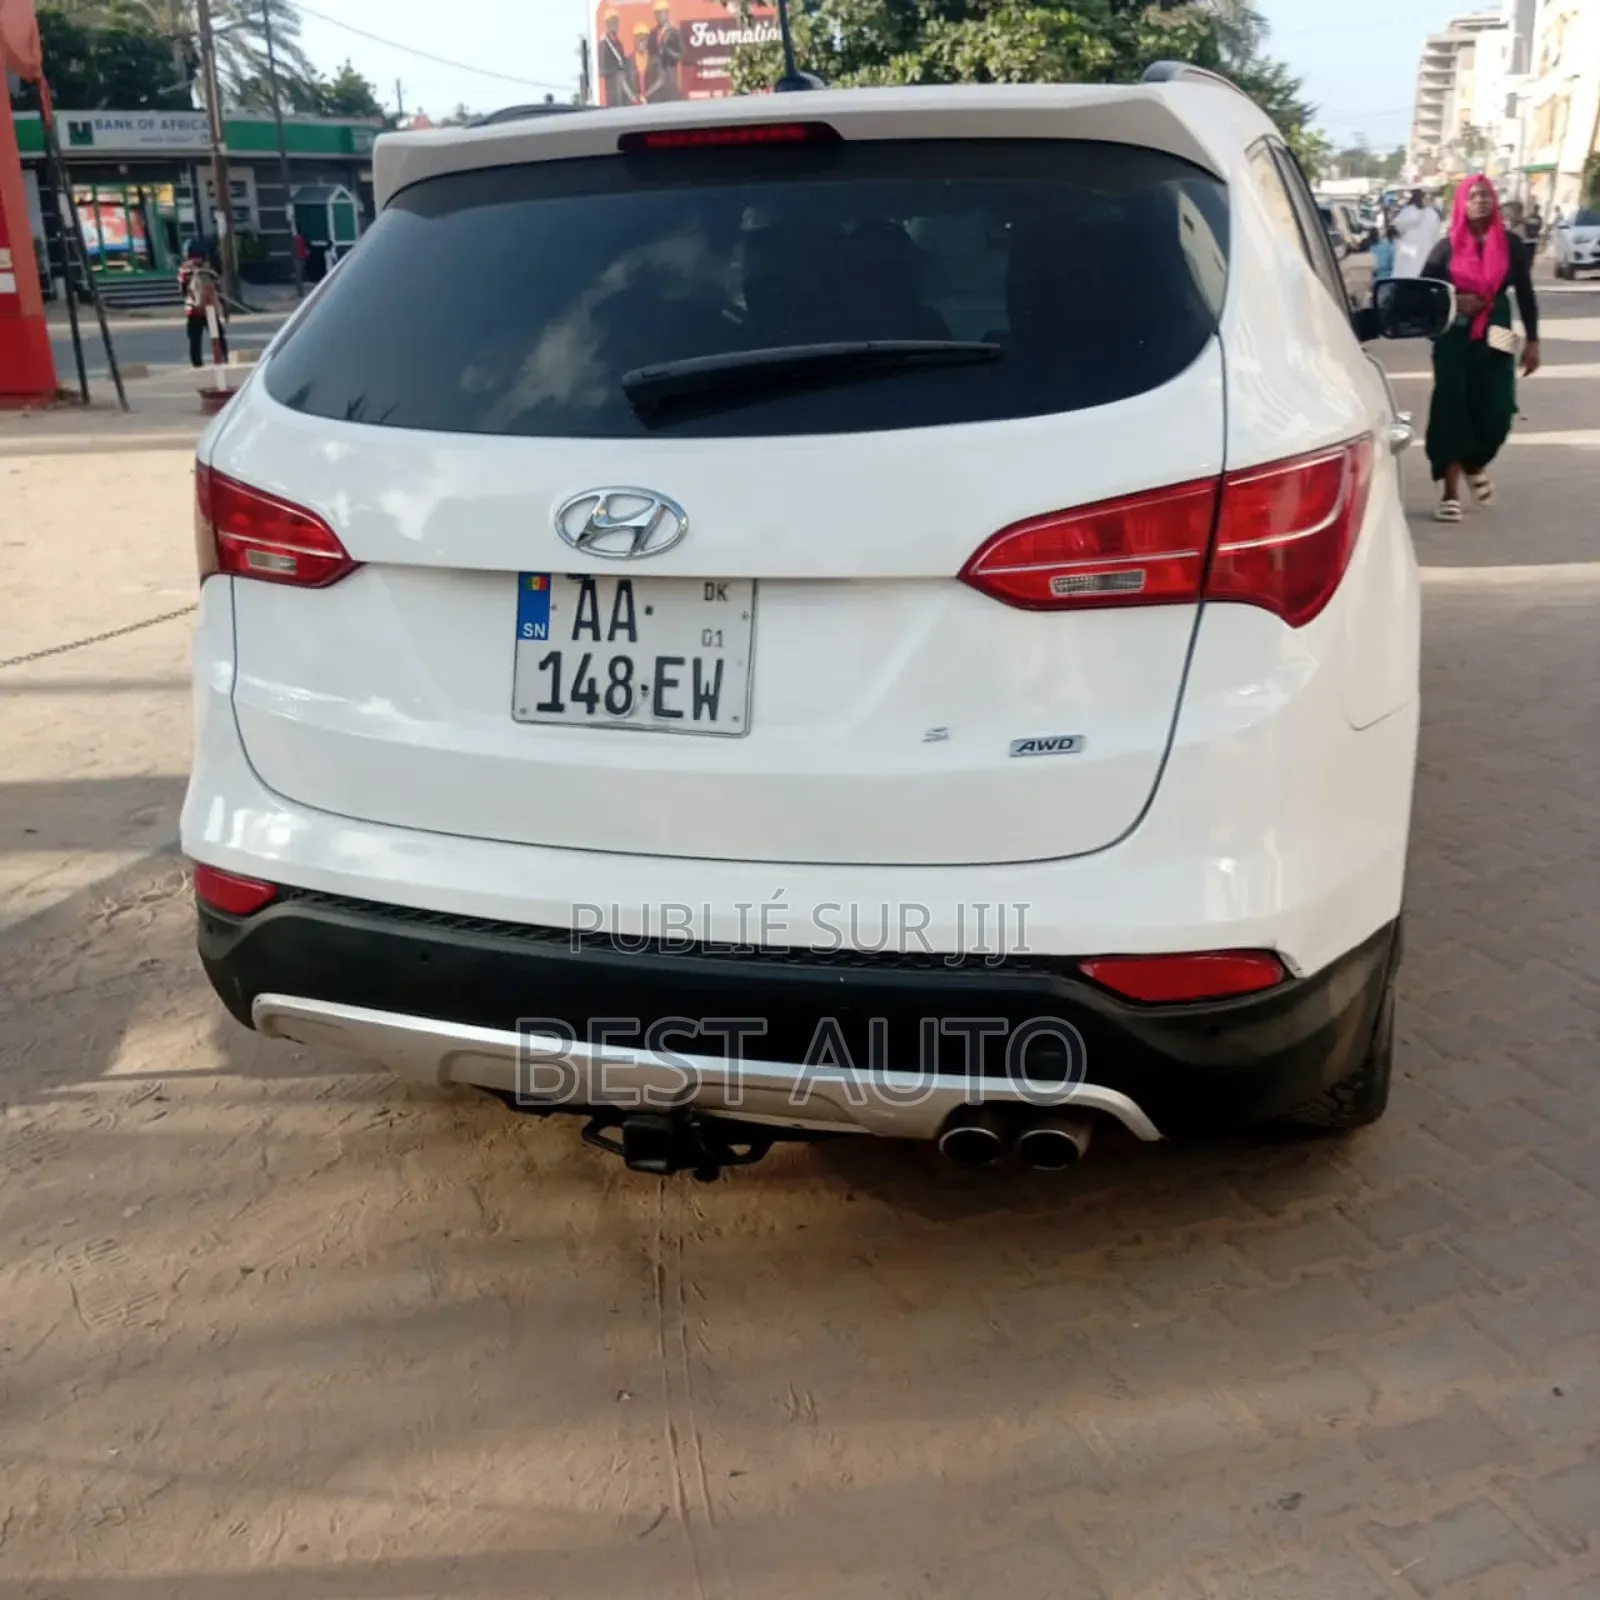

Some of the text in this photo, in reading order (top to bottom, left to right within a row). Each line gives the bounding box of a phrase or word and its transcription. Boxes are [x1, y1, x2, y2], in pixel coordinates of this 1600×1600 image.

[94, 117, 209, 131] BANK OF AFRICA
[704, 581, 729, 602] DK
[571, 577, 638, 643] AA
[523, 623, 546, 639] SN
[1015, 736, 1076, 754] AWD
